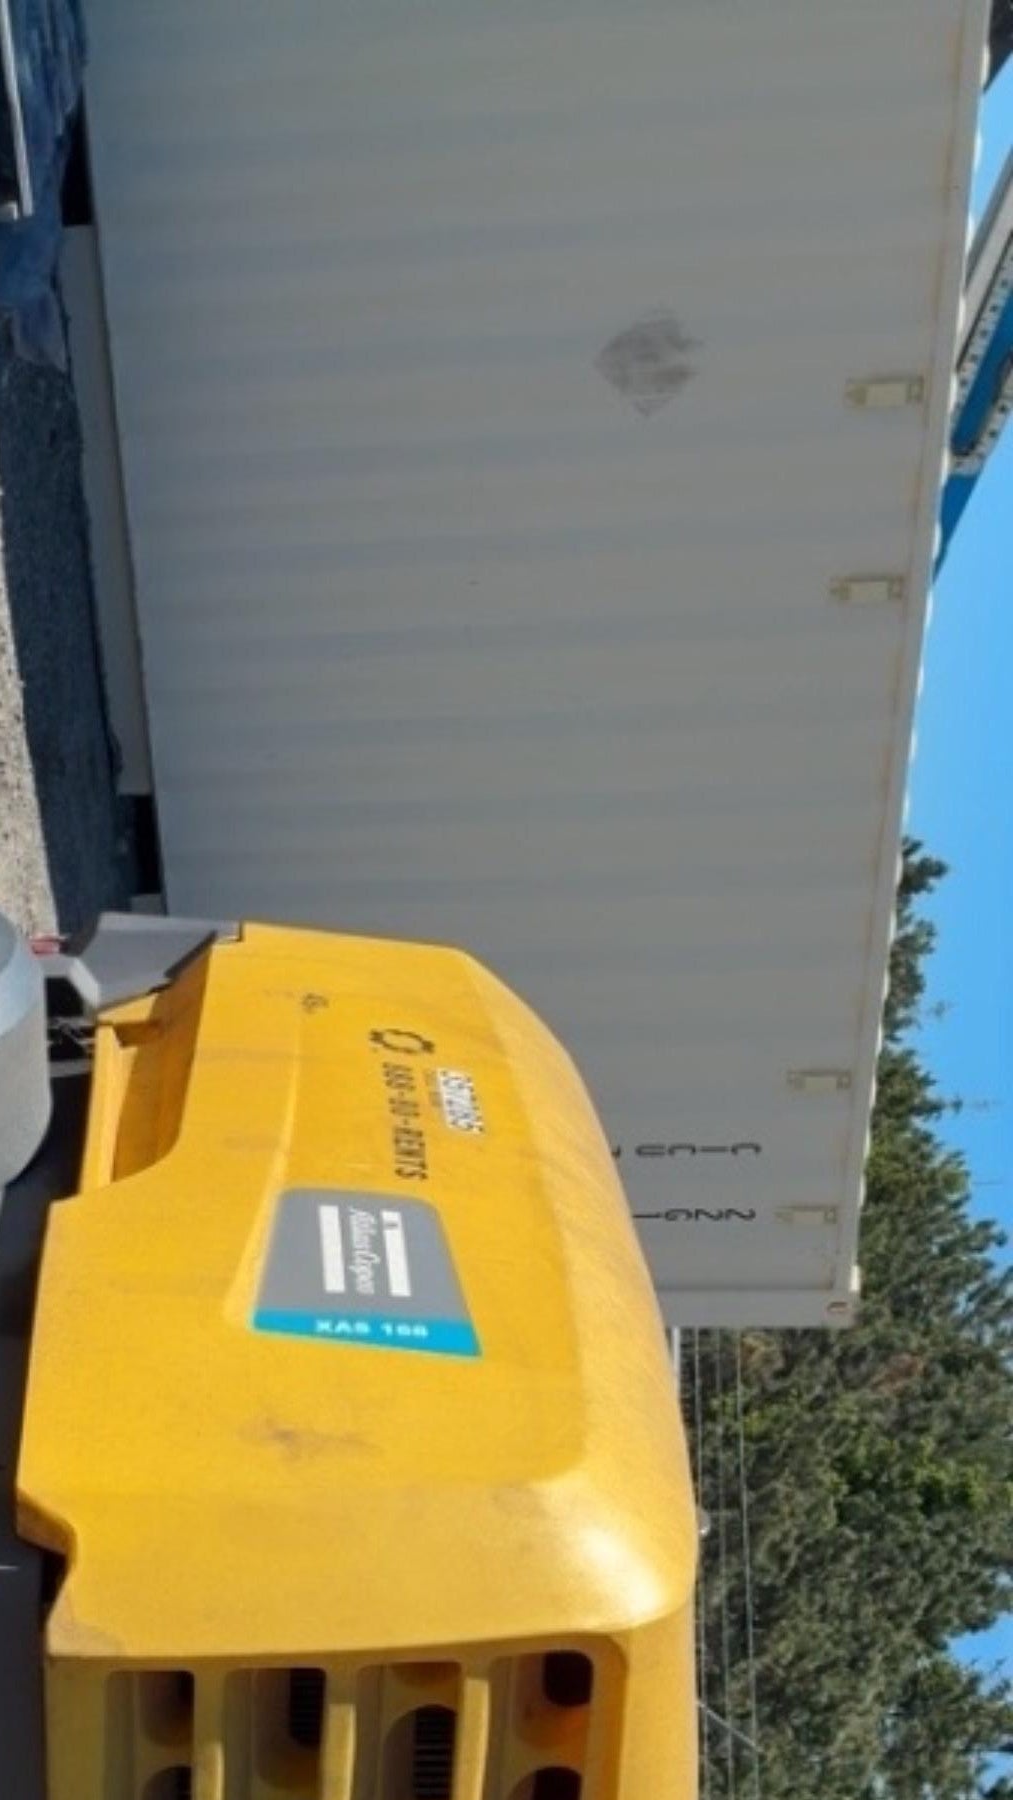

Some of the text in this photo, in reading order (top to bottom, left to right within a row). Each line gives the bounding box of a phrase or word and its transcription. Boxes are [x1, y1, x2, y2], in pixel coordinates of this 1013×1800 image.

[635, 1142, 763, 1158] CICU
[349, 1207, 380, 1295] Atlas Copco
[315, 1319, 370, 1335] XAS
